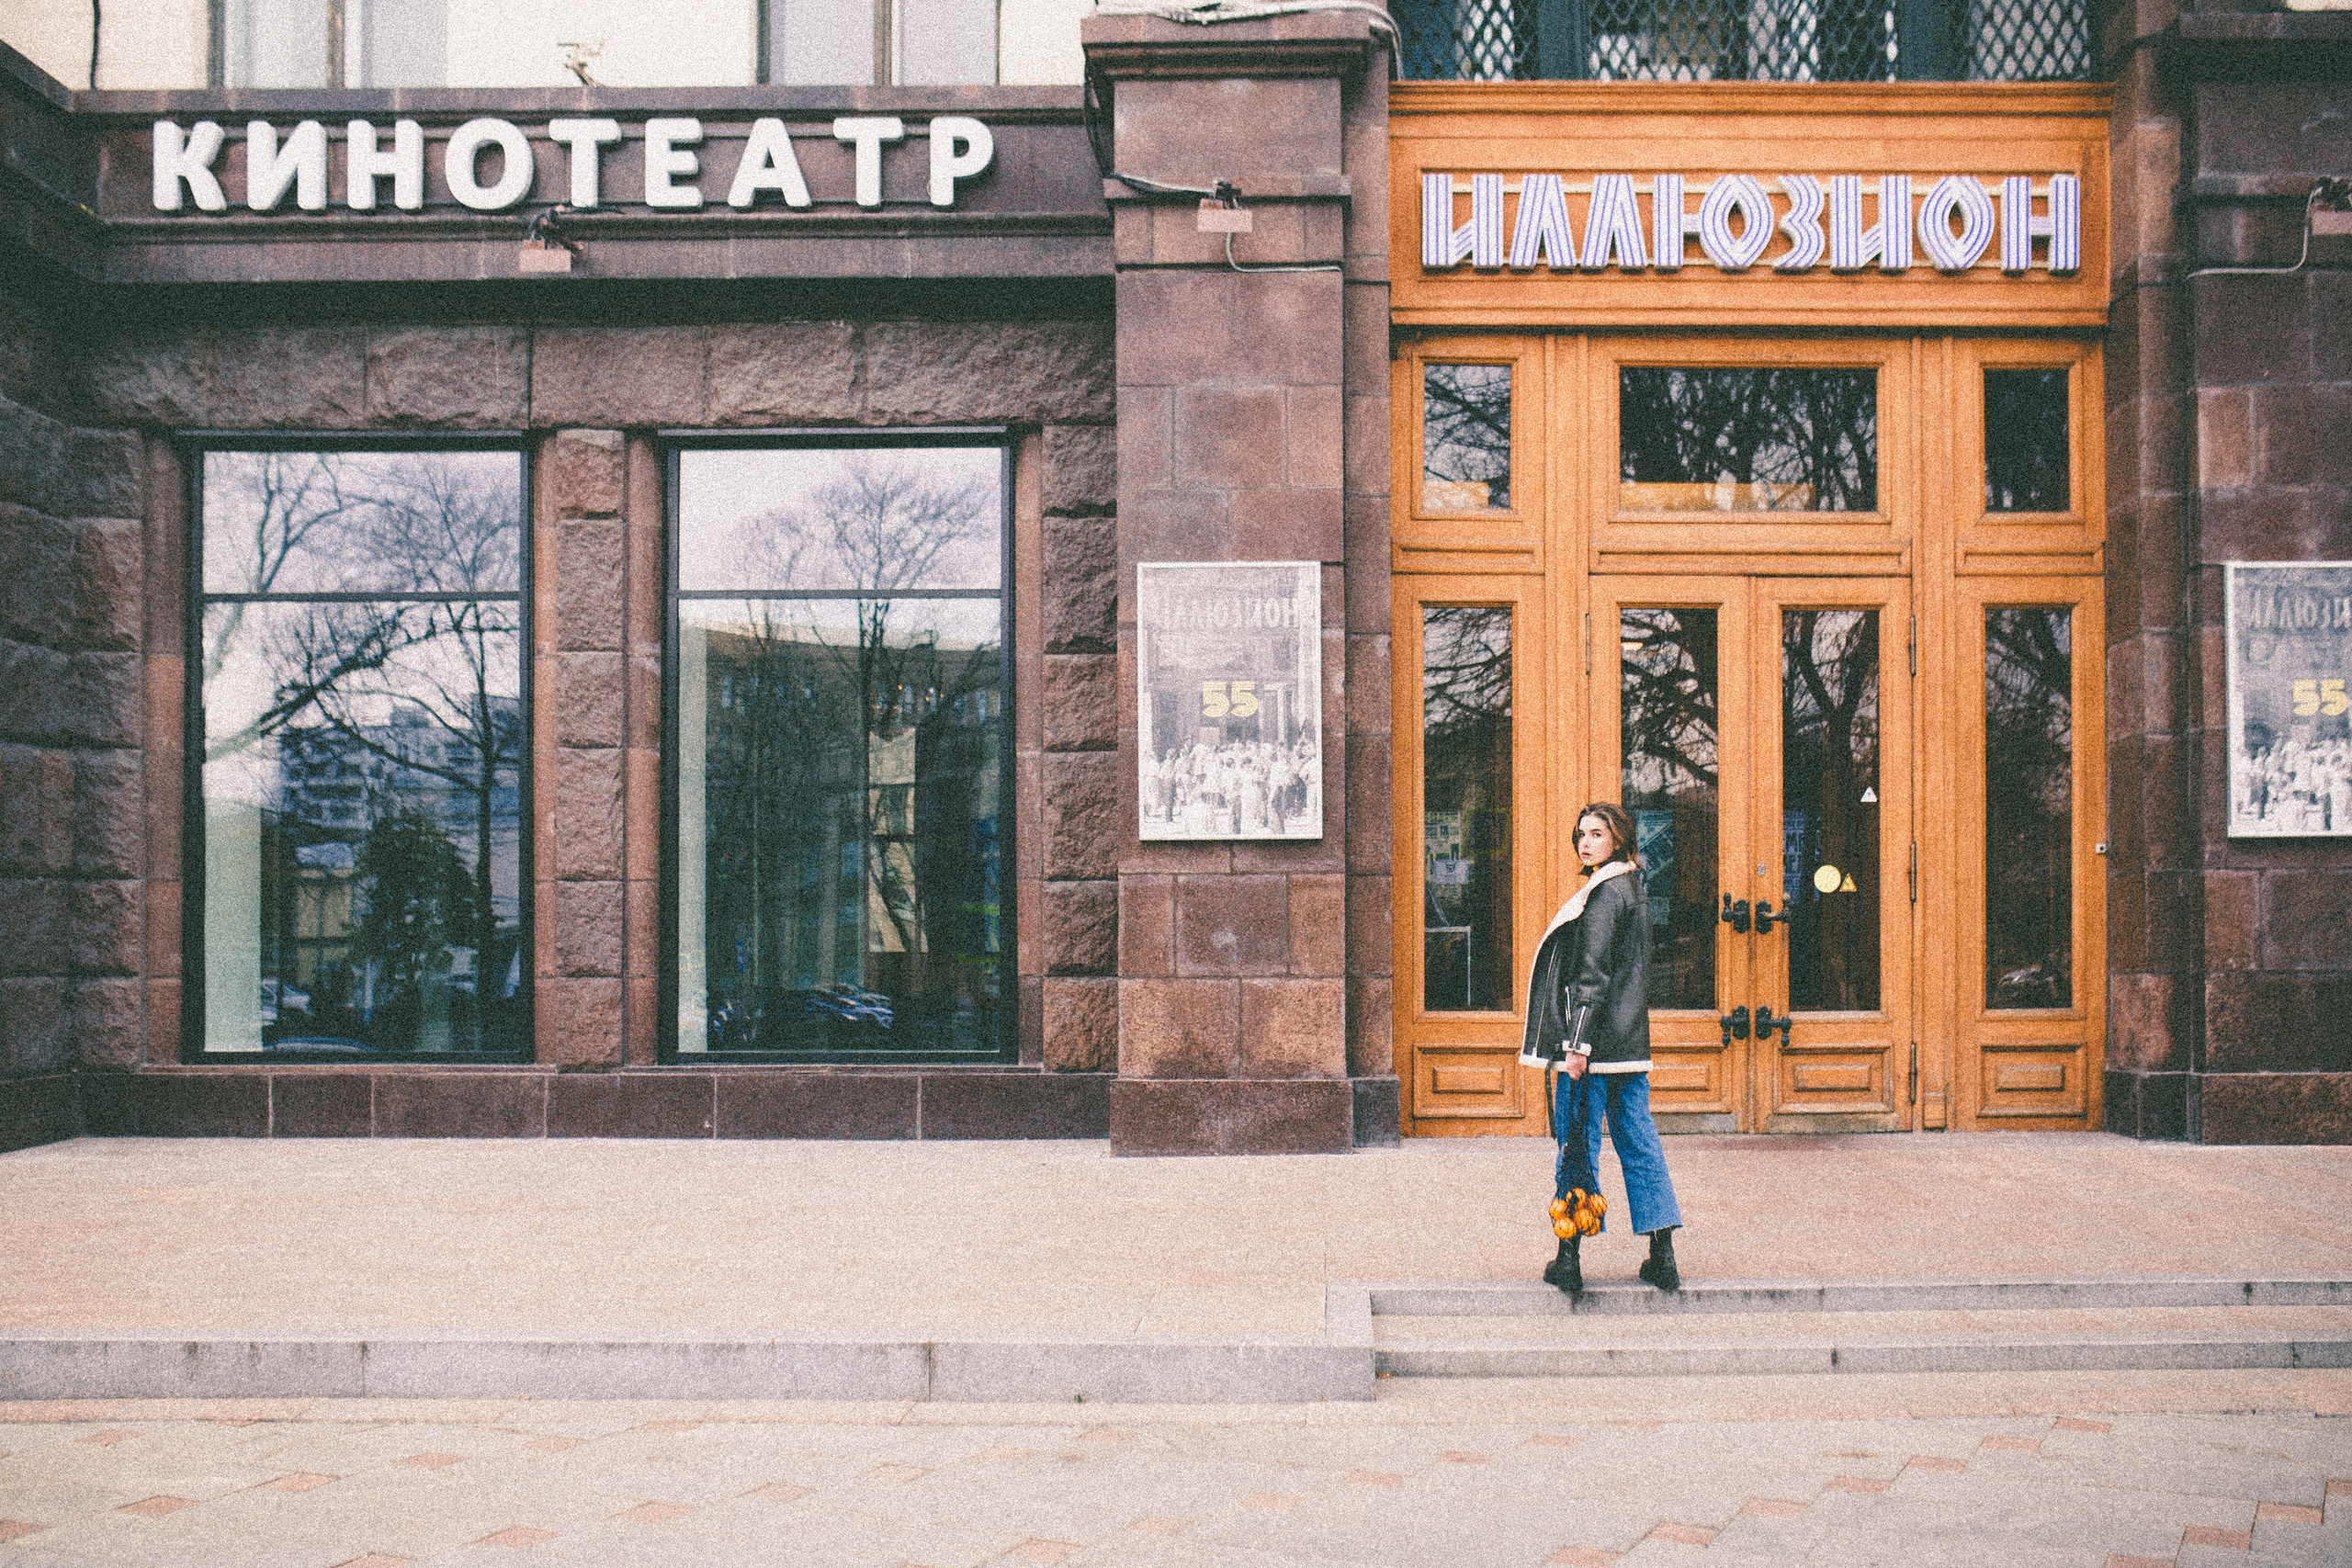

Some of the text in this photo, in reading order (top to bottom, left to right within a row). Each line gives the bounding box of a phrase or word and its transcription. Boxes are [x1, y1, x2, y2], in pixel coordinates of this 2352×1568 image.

[153, 117, 996, 210] КИНОТЕАТР
[1421, 174, 2081, 271] ИЛЛЮЗИОН
[1203, 681, 1258, 717] 55
[2293, 679, 2349, 716] 55
